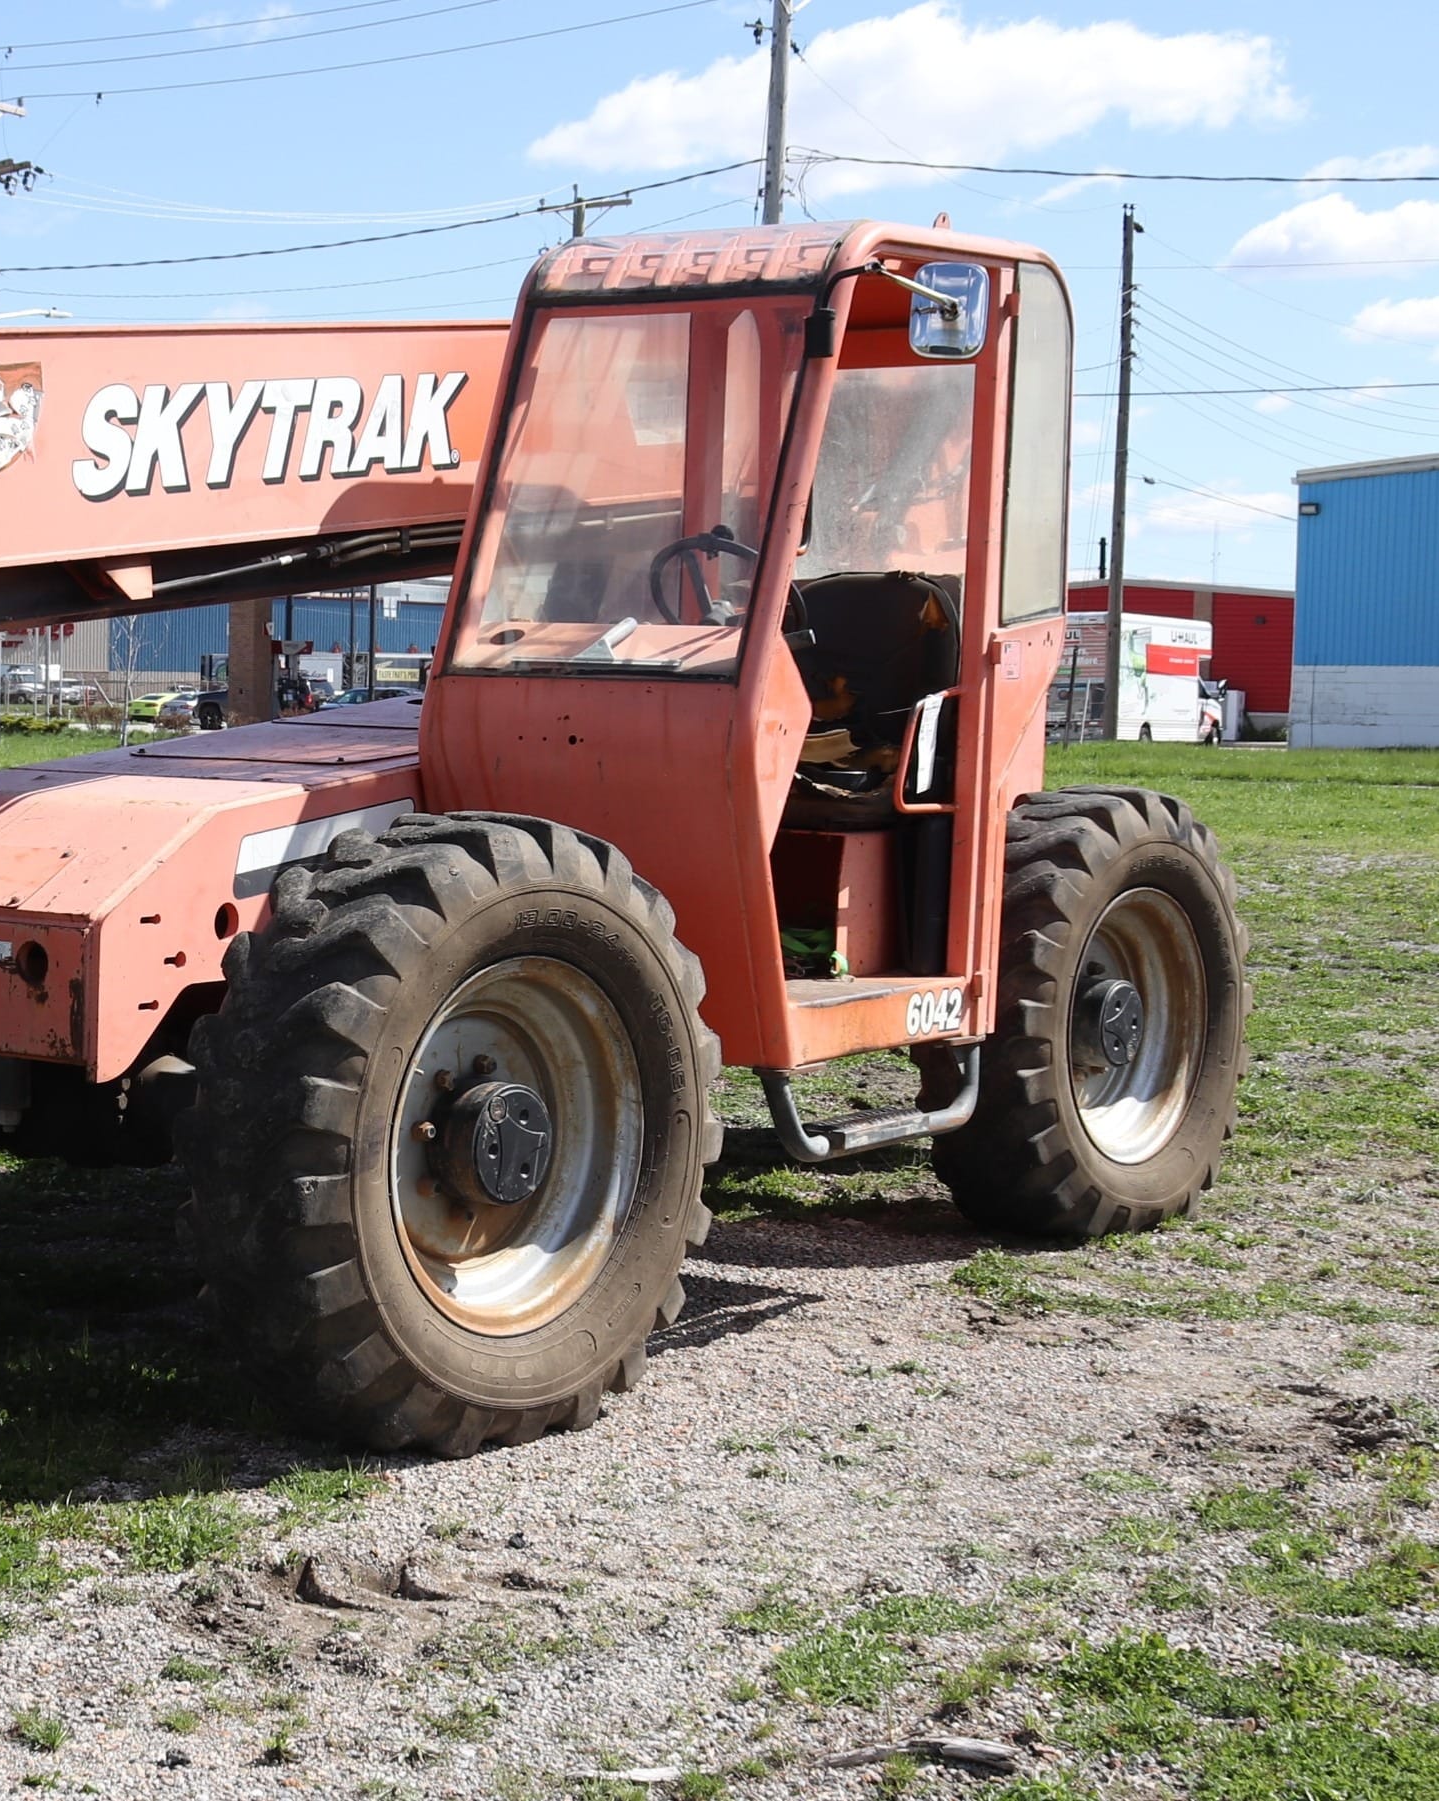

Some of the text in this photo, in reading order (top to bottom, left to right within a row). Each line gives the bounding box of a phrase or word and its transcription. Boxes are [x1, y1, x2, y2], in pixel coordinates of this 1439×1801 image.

[72, 372, 469, 502] SKYTRAK
[514, 906, 620, 952] 13.00-24
[906, 986, 963, 1037] 6042
